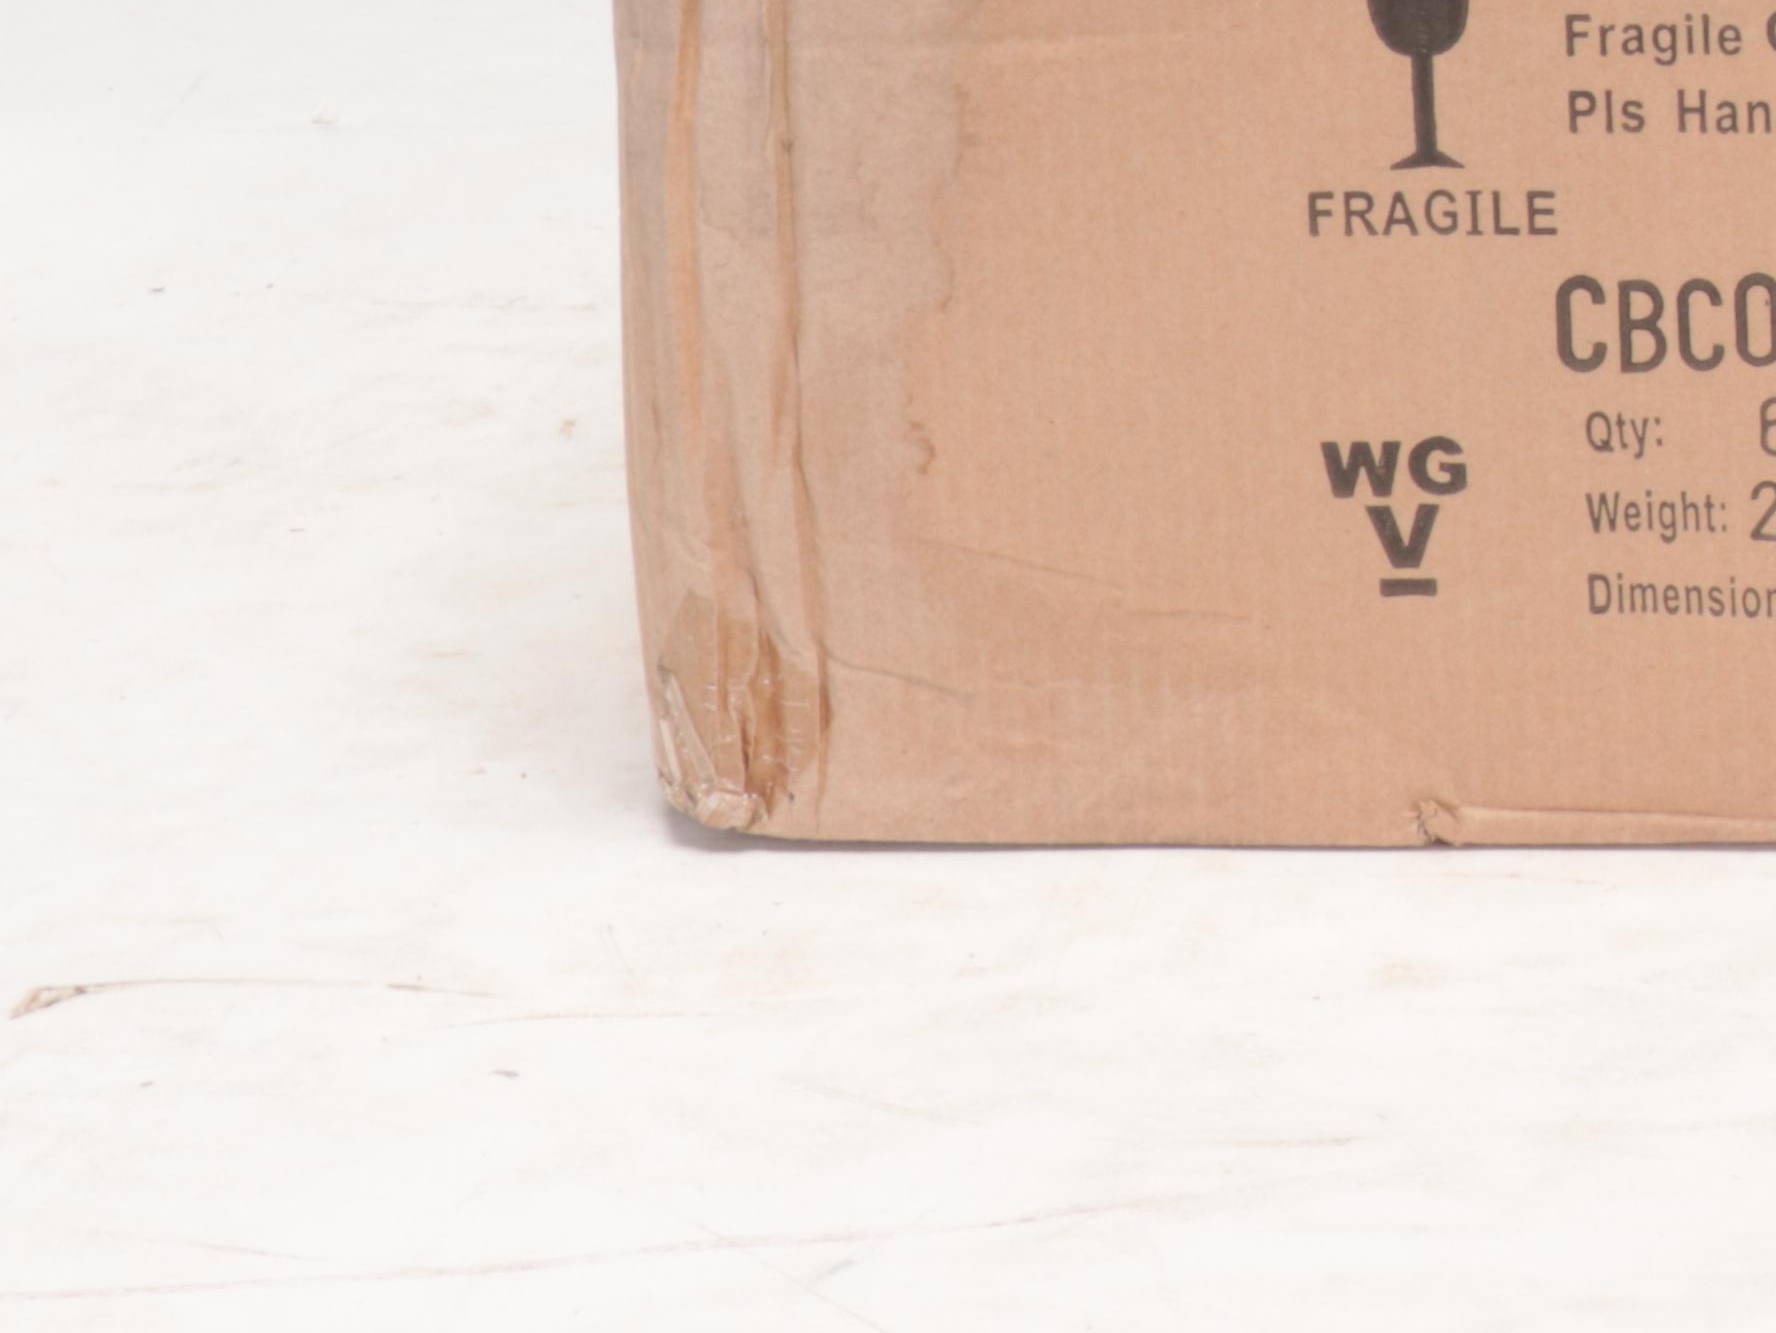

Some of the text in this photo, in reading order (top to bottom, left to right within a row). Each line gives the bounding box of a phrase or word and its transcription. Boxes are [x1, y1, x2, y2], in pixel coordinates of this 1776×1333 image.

[1564, 13, 1742, 67] Fragile
[1567, 89, 1646, 134] Pls
[1307, 188, 1558, 238] FRAGILE
[1585, 410, 1663, 460] Qty:
[1320, 435, 1468, 499] WG
[1365, 503, 1440, 569] V
[1584, 489, 1727, 545] Weight:
